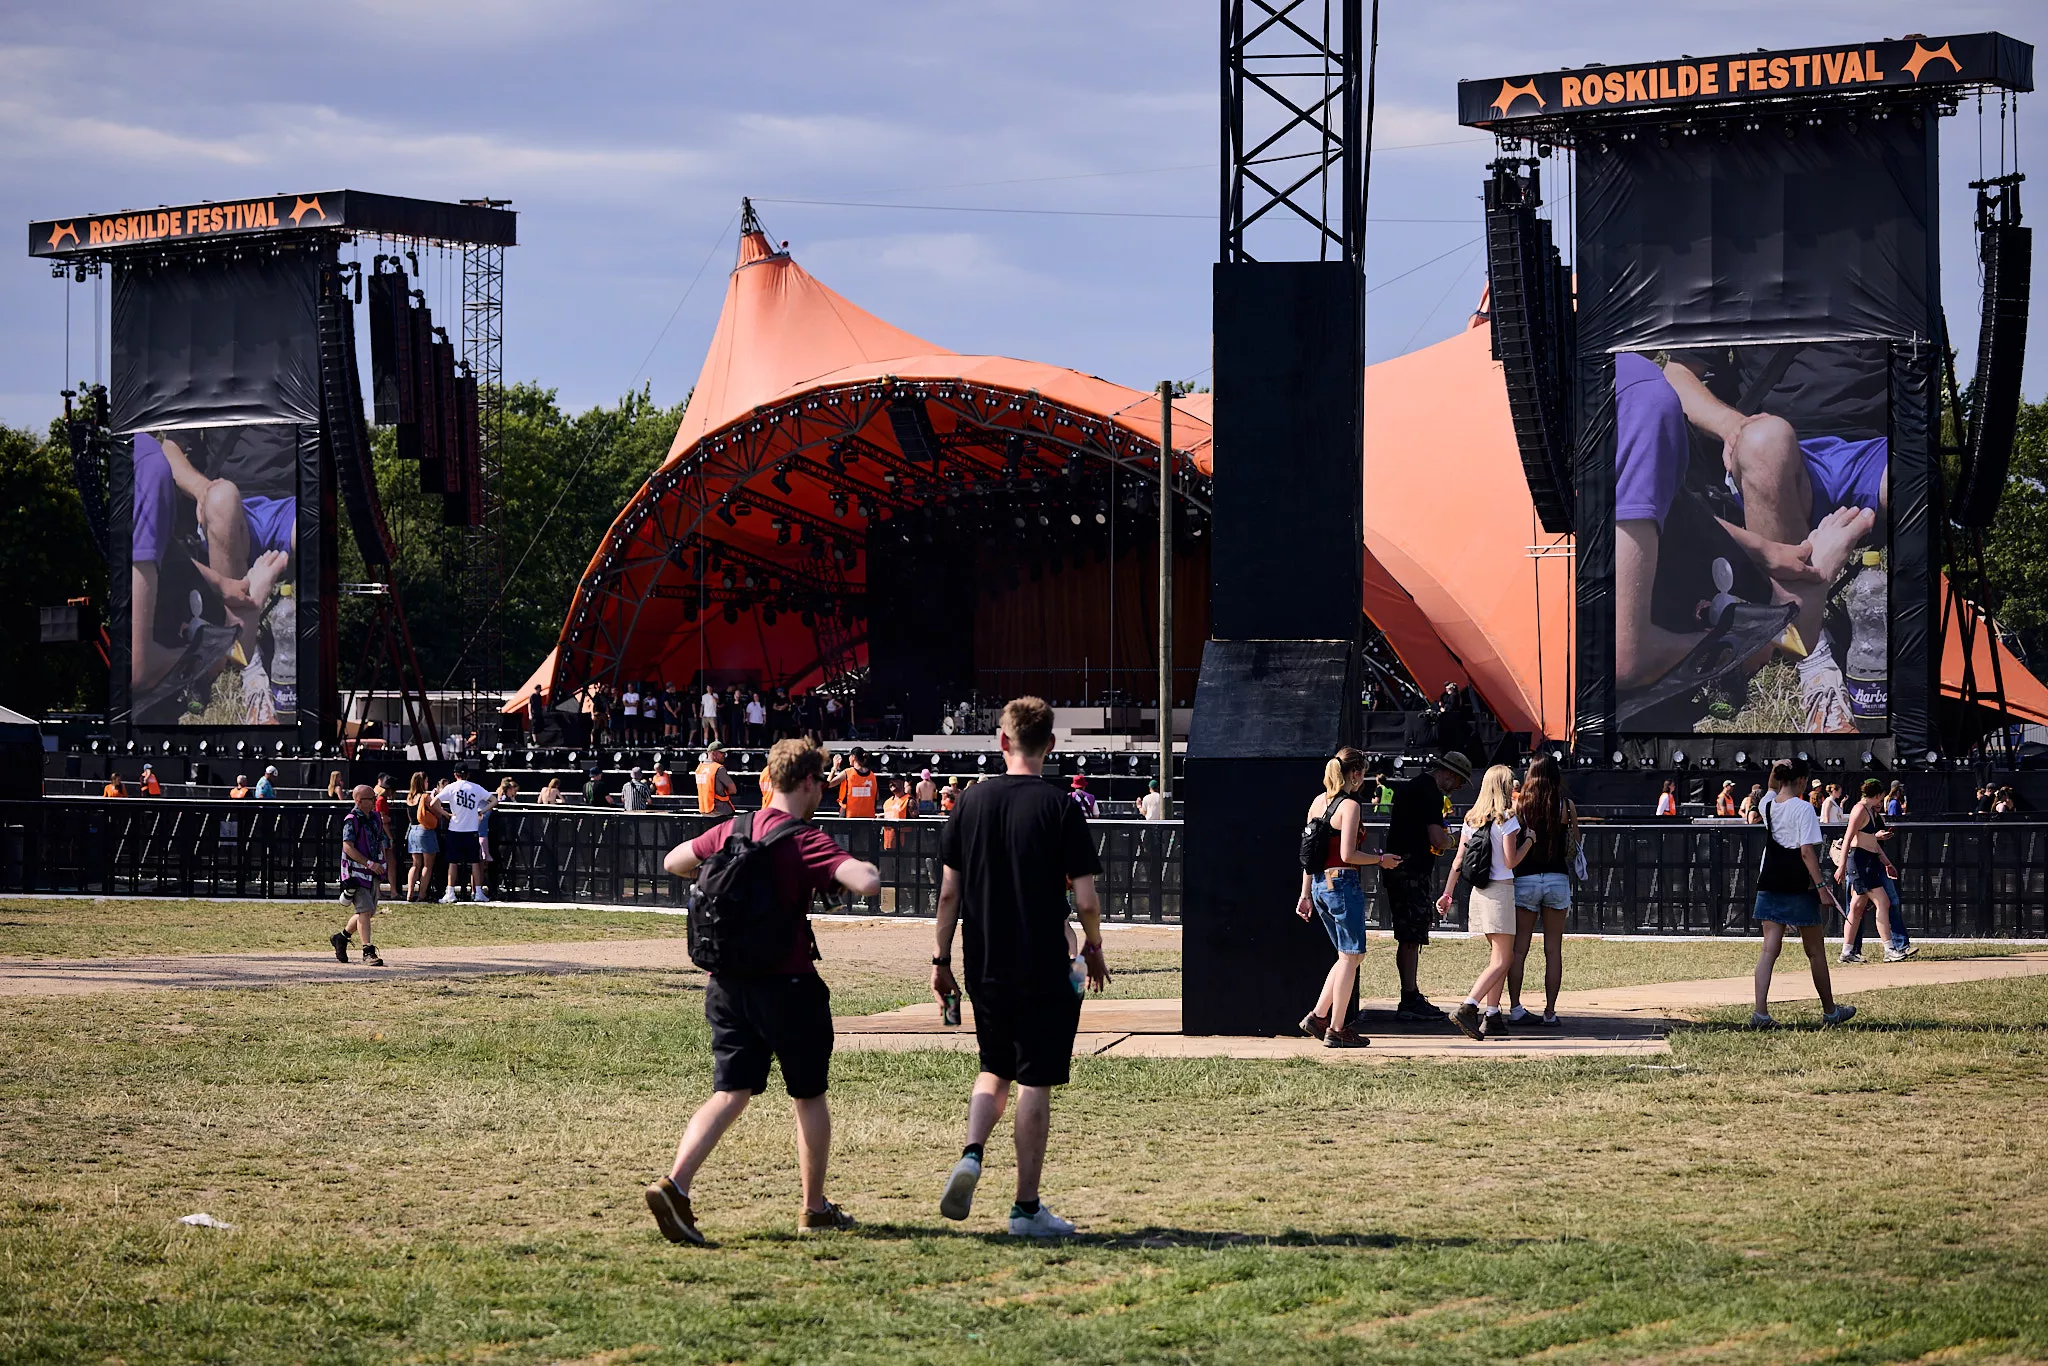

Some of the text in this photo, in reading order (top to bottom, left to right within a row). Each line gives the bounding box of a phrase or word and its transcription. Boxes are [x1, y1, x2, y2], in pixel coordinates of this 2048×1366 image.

[1561, 49, 1884, 108] ROSKILDE FESTIVAL
[89, 201, 279, 245] ROSKILDE FESTIVAL
